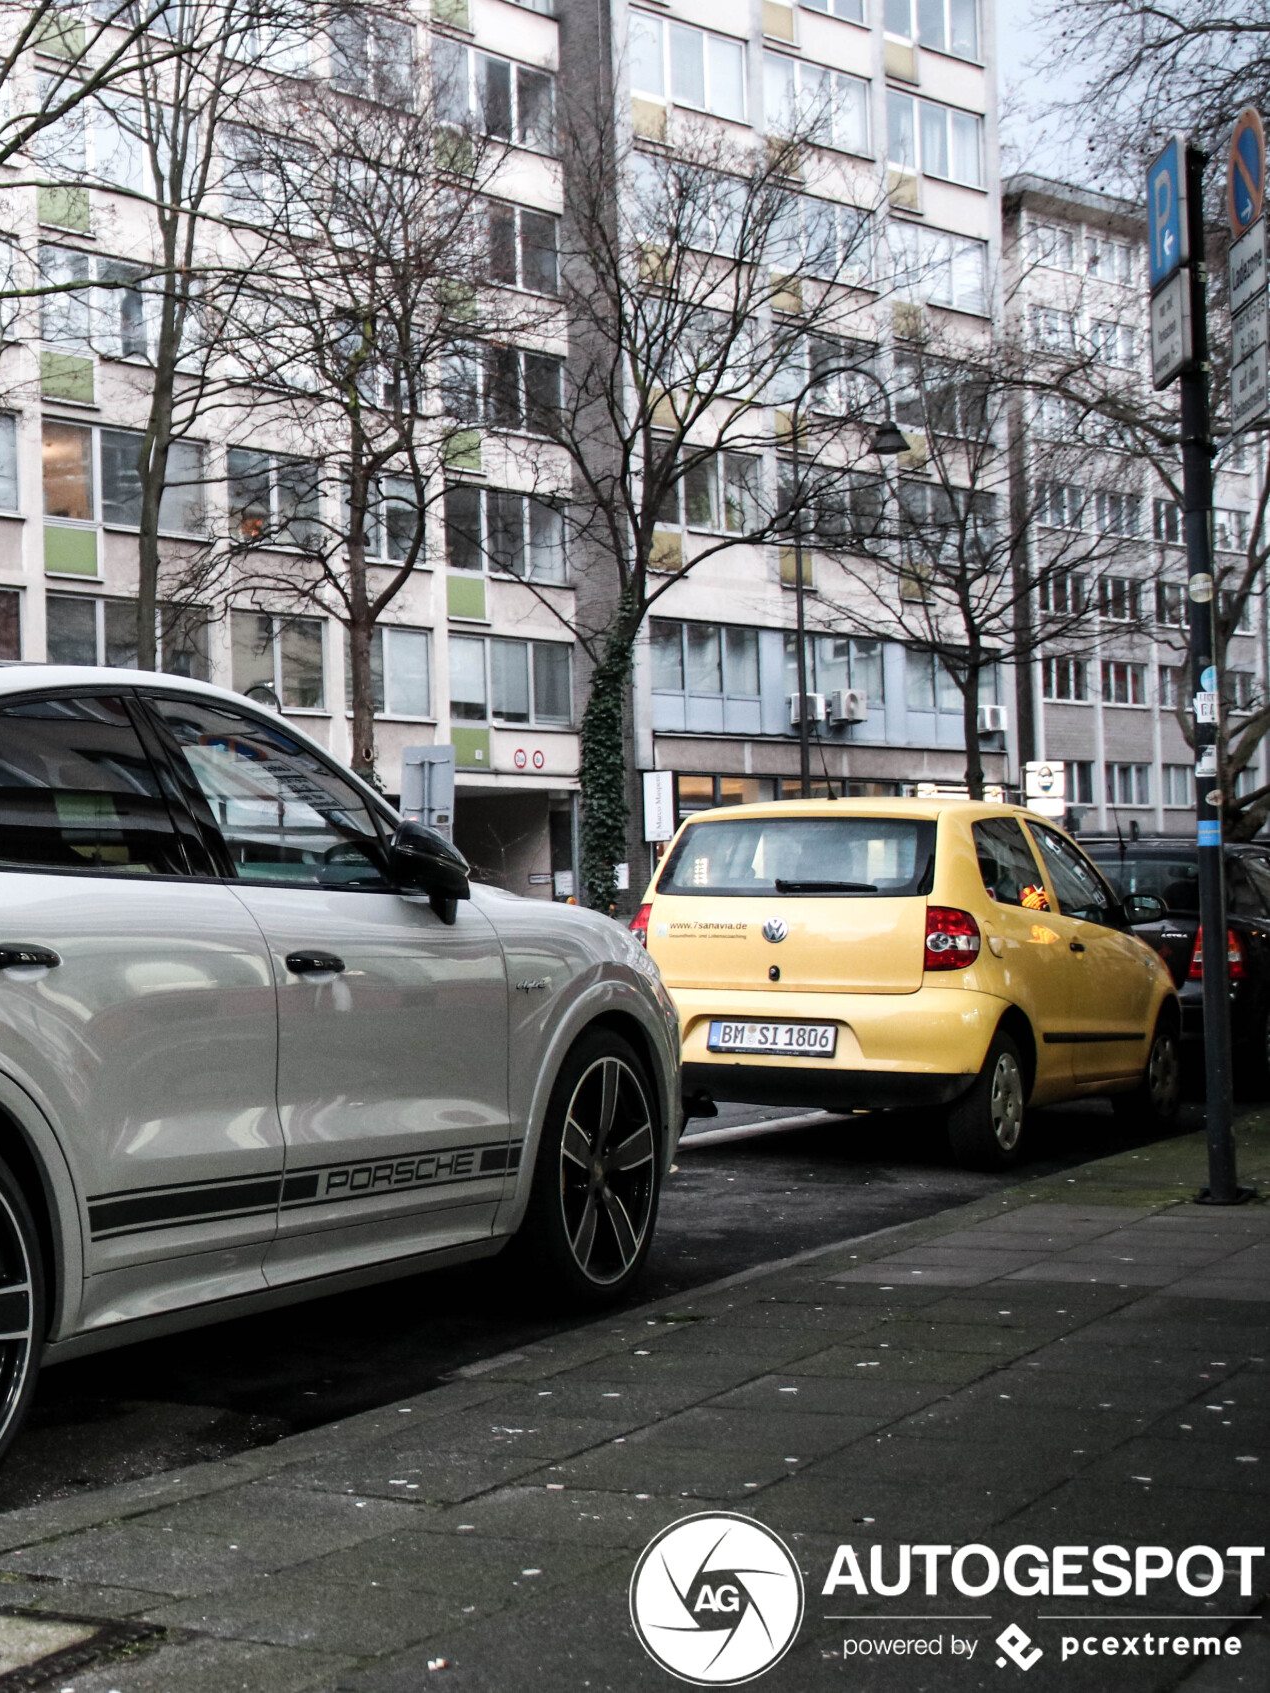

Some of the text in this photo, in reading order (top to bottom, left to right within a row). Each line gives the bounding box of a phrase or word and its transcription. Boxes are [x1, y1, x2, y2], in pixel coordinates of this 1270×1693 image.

[1155, 169, 1171, 267] P
[1232, 248, 1262, 291] Ladezone
[670, 921, 748, 930] www.7sanavia.de
[721, 1025, 829, 1048] BM SI 1806
[325, 1152, 475, 1195] PORSCHE
